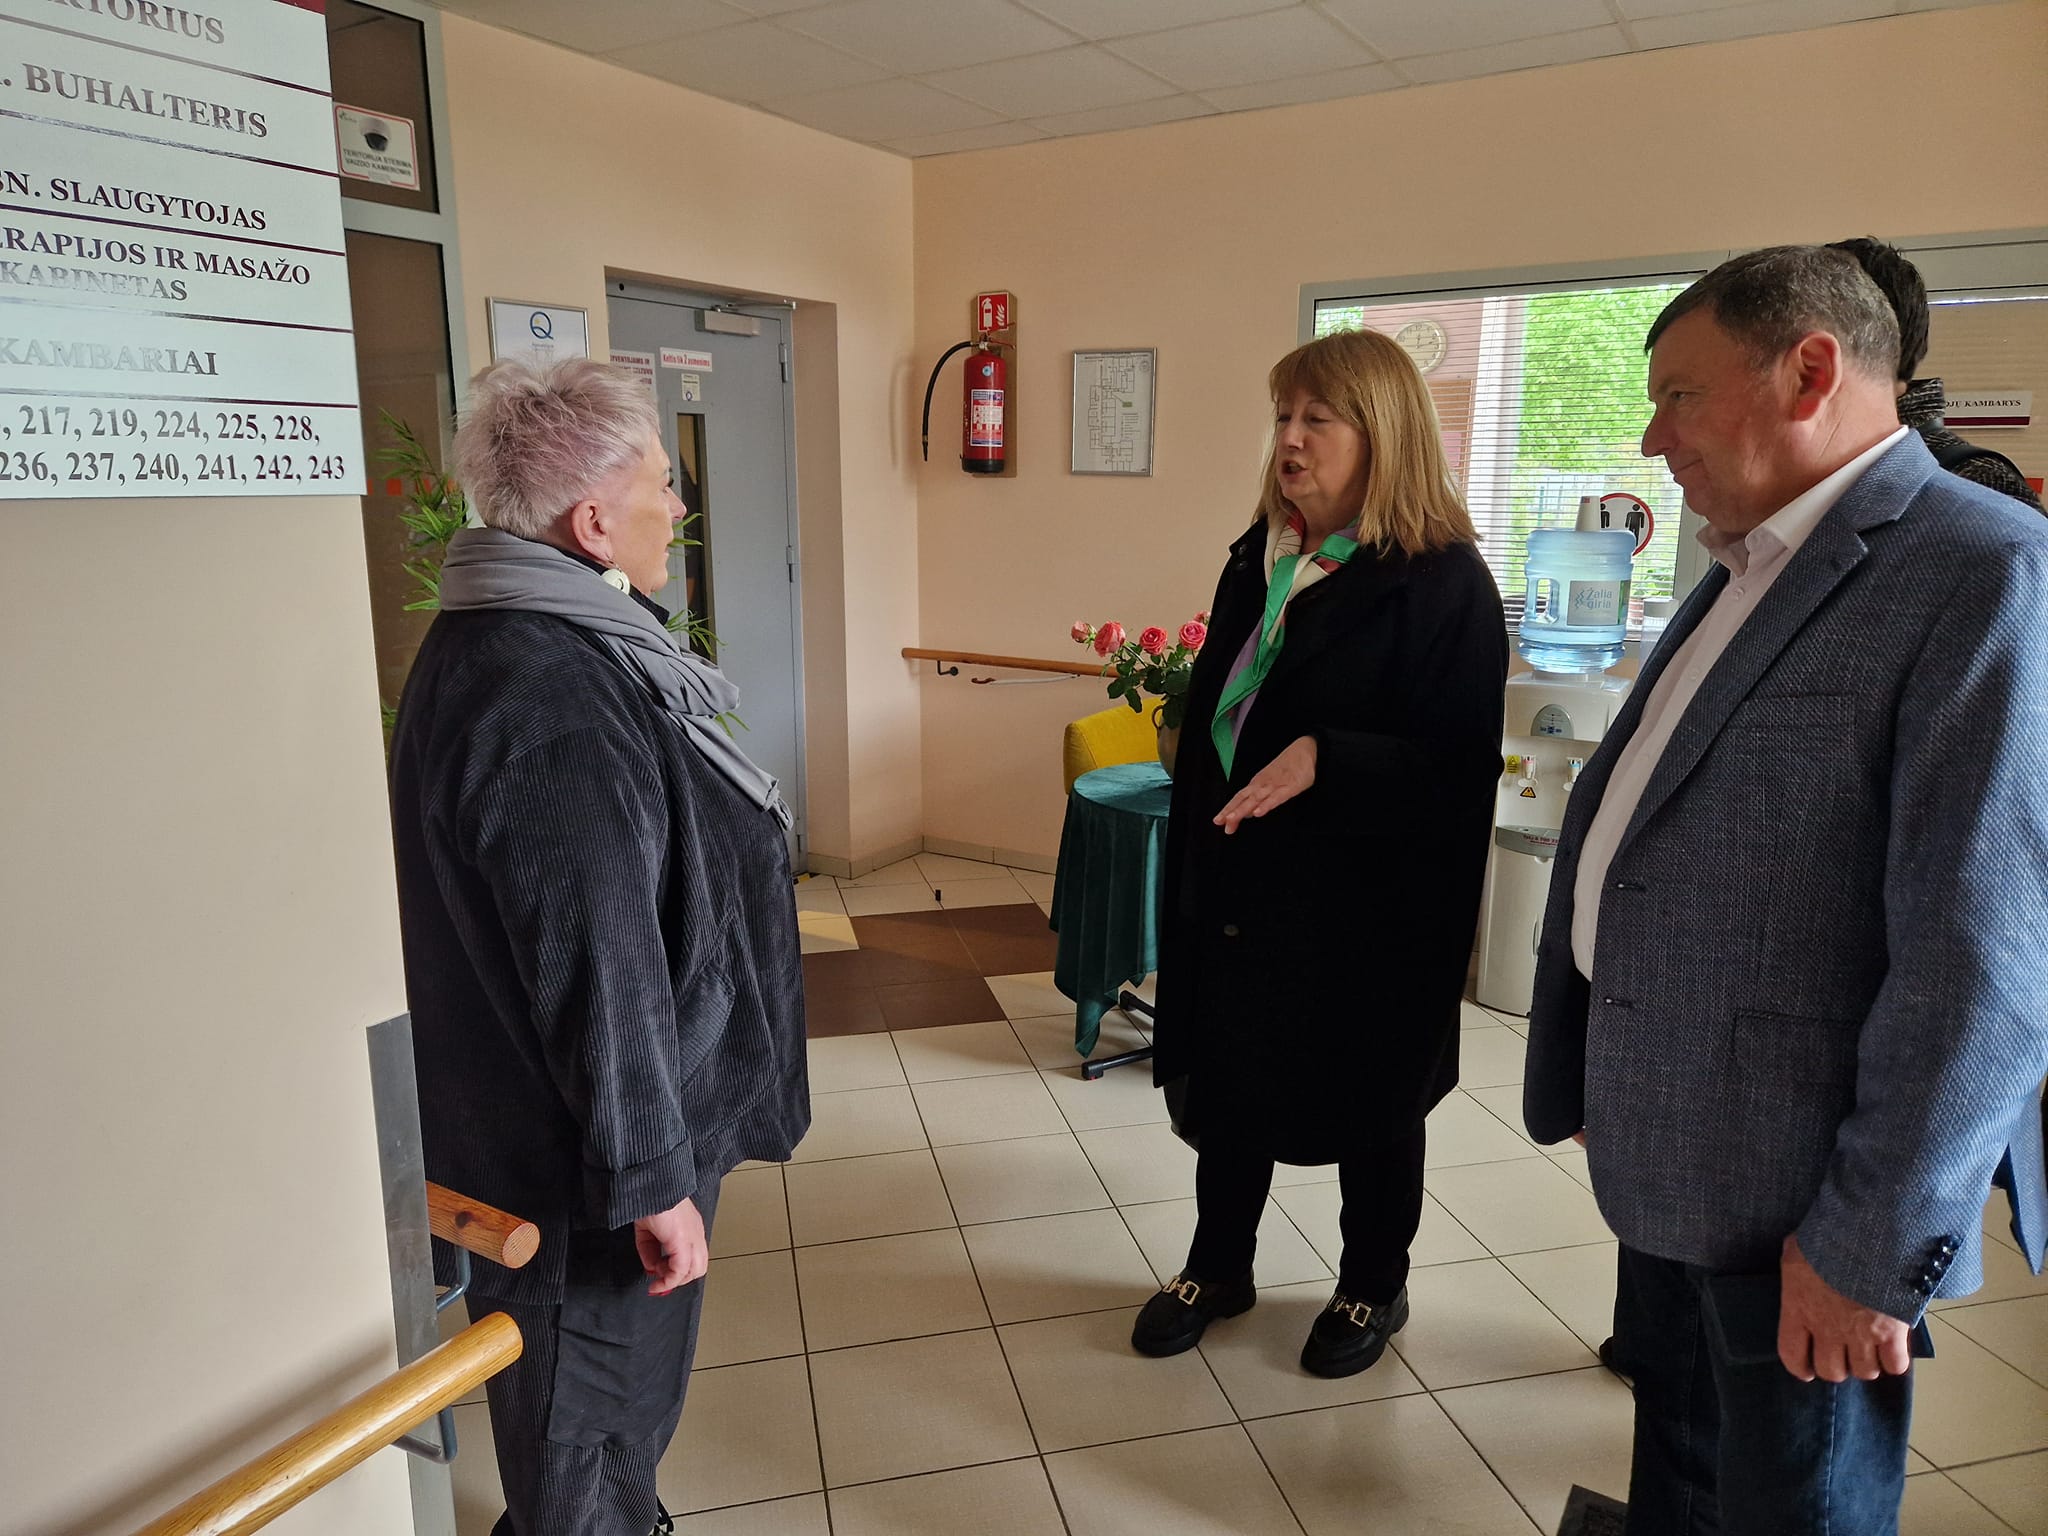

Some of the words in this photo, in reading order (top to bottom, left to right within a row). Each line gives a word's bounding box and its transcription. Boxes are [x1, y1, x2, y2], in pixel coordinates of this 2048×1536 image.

[49, 0, 225, 44] ORIUS
[22, 63, 268, 138] BUHALTERIS
[0, 170, 41, 197] N.
[51, 178, 266, 231] SLAUGYTOJAS
[0, 227, 146, 265] RAPIJOS
[154, 246, 189, 270] IR
[195, 250, 311, 285] MASAŽO
[0, 260, 187, 301] KABINETAS
[0, 337, 218, 376] KAMBARIAI
[1965, 400, 2022, 408] KAMBARYS
[19, 405, 82, 441] 217,
[89, 407, 147, 443] 219,
[154, 410, 209, 443] 224,
[216, 413, 267, 444] 225,
[274, 415, 320, 445] 228,
[0, 451, 58, 486] 236,
[66, 452, 125, 486] 237,
[133, 452, 188, 486] 240,
[198, 453, 247, 485] 241,
[254, 454, 302, 485] 242,
[309, 455, 345, 480] 243
